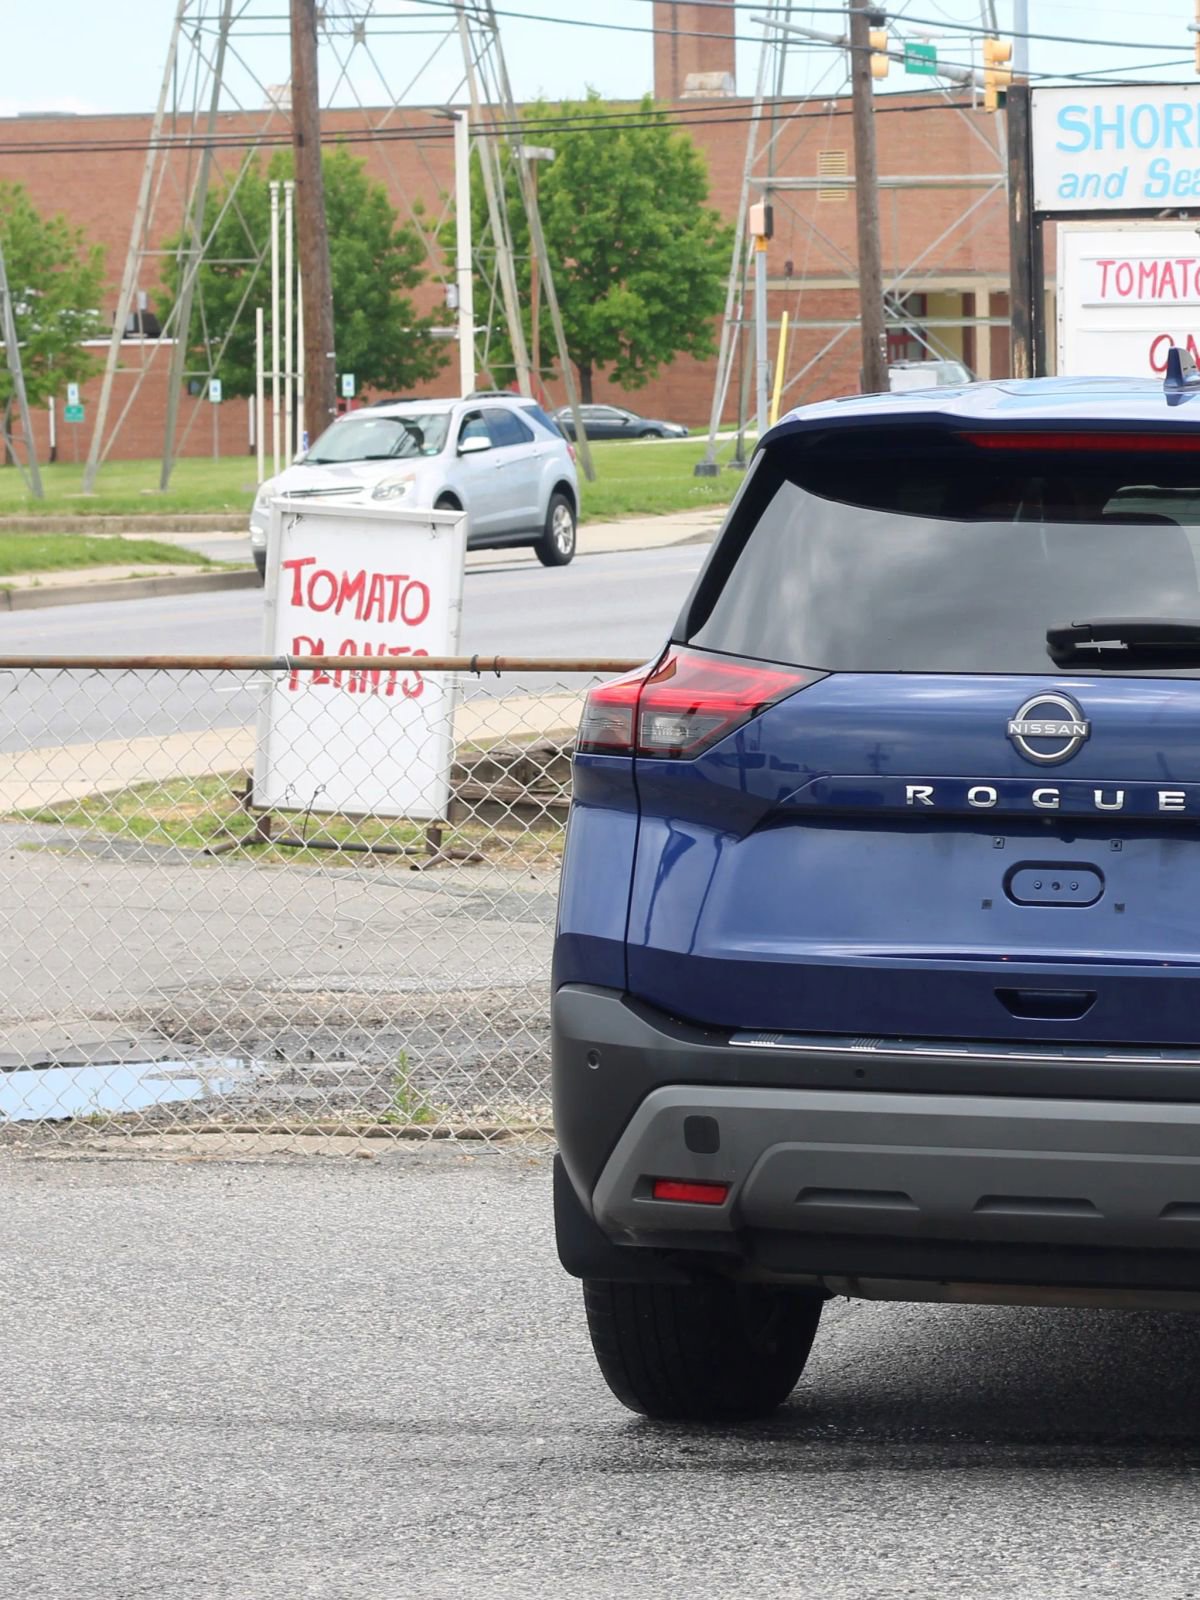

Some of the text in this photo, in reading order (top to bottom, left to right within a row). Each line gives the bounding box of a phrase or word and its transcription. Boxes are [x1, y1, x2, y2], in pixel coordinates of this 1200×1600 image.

[1057, 166, 1128, 199] and
[282, 556, 431, 626] TOMATO
[288, 635, 430, 698] PLANTS
[1009, 722, 1087, 736] NISSAN
[905, 785, 1187, 811] ROGUE
